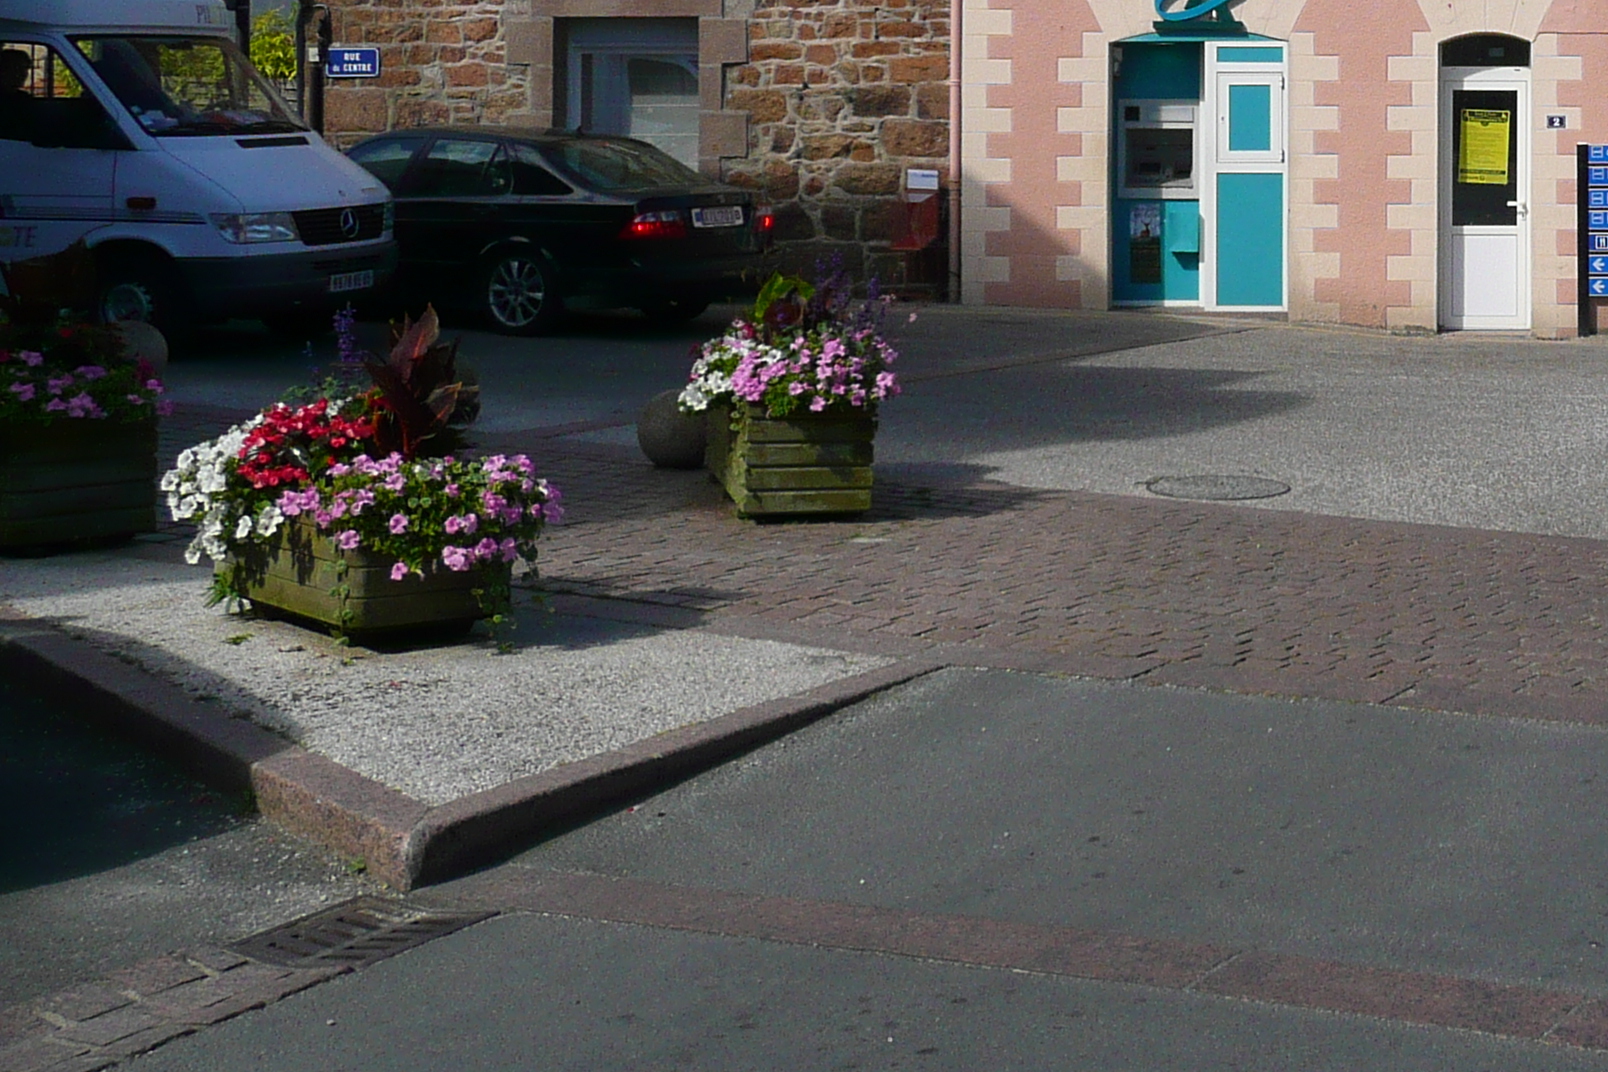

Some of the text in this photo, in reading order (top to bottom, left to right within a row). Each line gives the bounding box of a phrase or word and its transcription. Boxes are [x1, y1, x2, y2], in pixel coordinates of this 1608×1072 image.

[343, 52, 361, 61] RUE
[343, 63, 372, 72] CENTRE
[1552, 117, 1560, 127] 2
